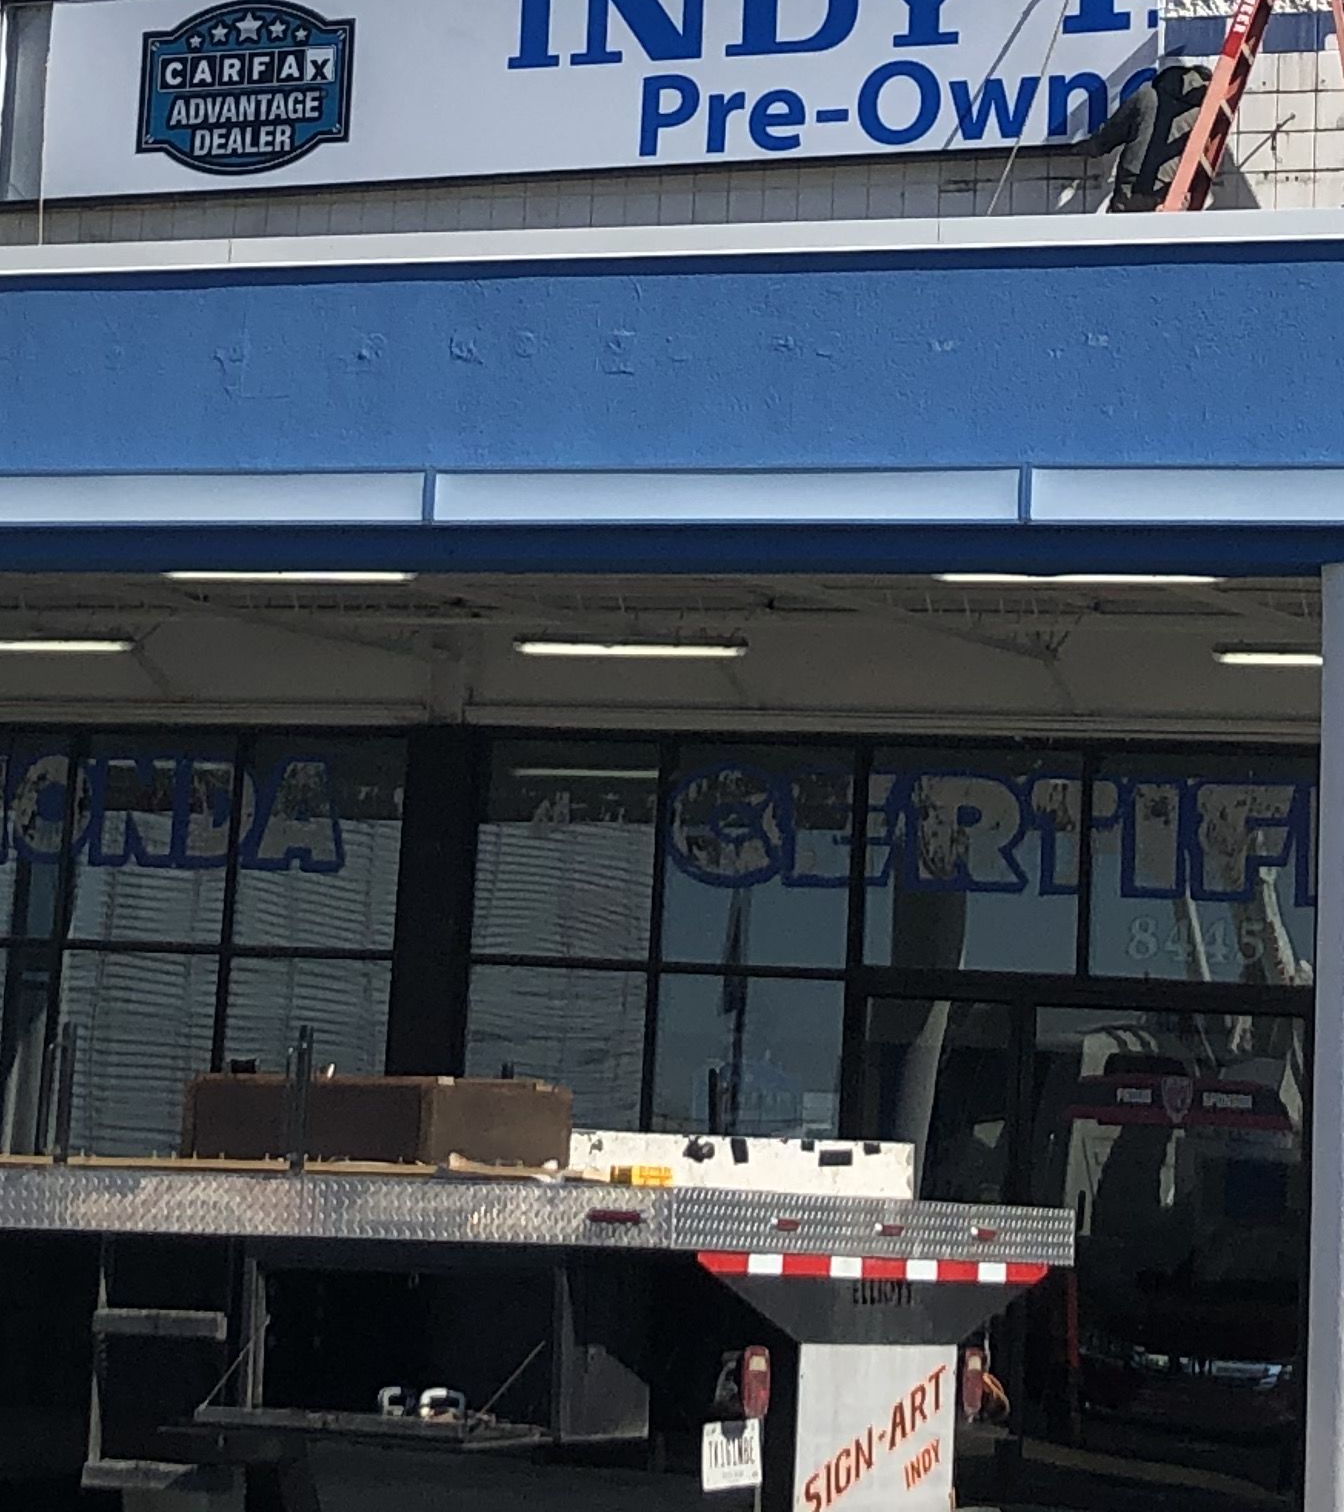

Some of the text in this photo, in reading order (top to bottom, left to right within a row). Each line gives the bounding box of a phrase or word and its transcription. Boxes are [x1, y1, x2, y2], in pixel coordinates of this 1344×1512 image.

[164, 52, 332, 86] CARFAX
[169, 90, 321, 126] ADVANTAGE
[638, 59, 1156, 156] Pre-Own
[193, 124, 293, 156] DEALER
[803, 1364, 948, 1512] SIGN-ART
[904, 1438, 943, 1491] INDY
